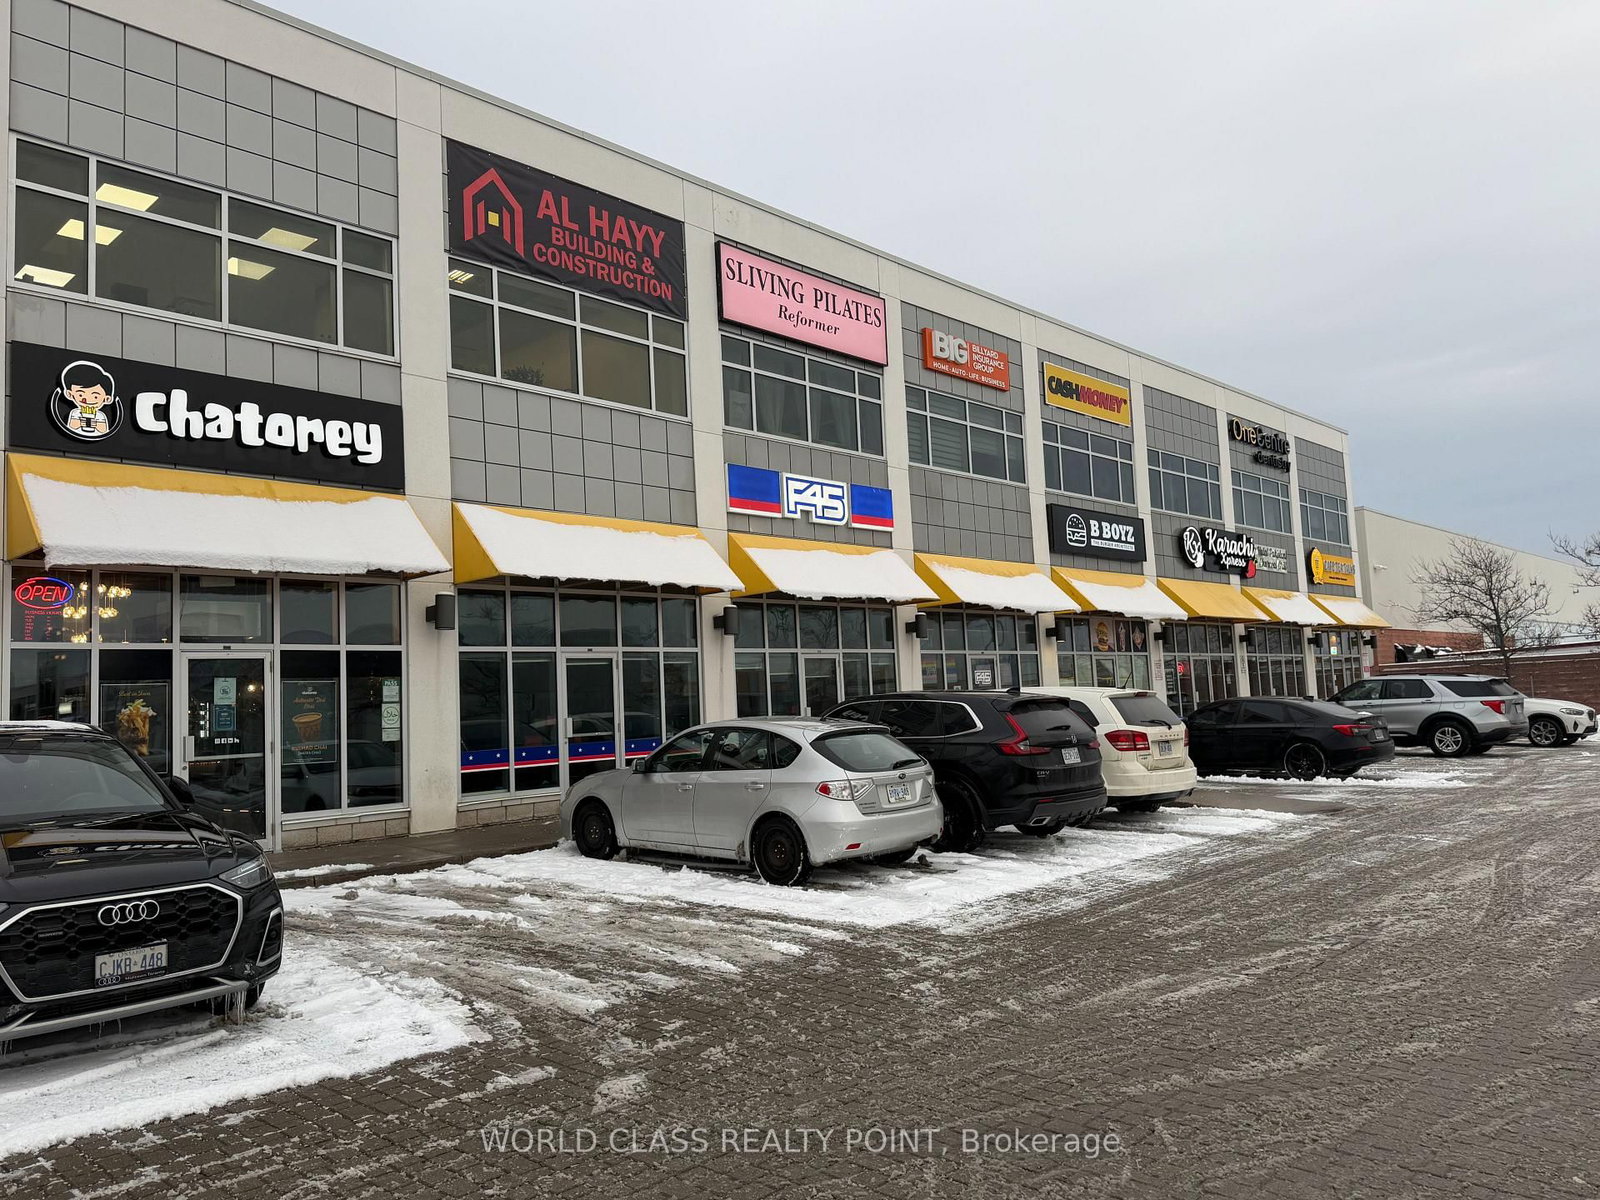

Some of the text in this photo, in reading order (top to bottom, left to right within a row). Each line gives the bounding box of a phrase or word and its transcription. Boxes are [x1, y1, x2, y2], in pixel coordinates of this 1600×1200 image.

[536, 189, 665, 258] AL HAYY
[551, 226, 655, 276] BUILDING &
[532, 244, 673, 301] CONSTRUCTION
[725, 256, 882, 329] SLIVING PILATES
[778, 304, 840, 336] Reformer
[931, 329, 968, 365] BIG
[971, 344, 999, 359] BILLYARD
[972, 354, 1005, 370] INSURANCE
[933, 361, 1006, 388] HOME AUTO LIFE BUSINESS
[972, 362, 994, 374] GROUP
[785, 476, 845, 523] F45
[1089, 519, 1135, 543] B BOYZ
[1205, 528, 1256, 558] Karachi
[1220, 552, 1247, 570] Xpress
[18, 585, 68, 602] OPEN
